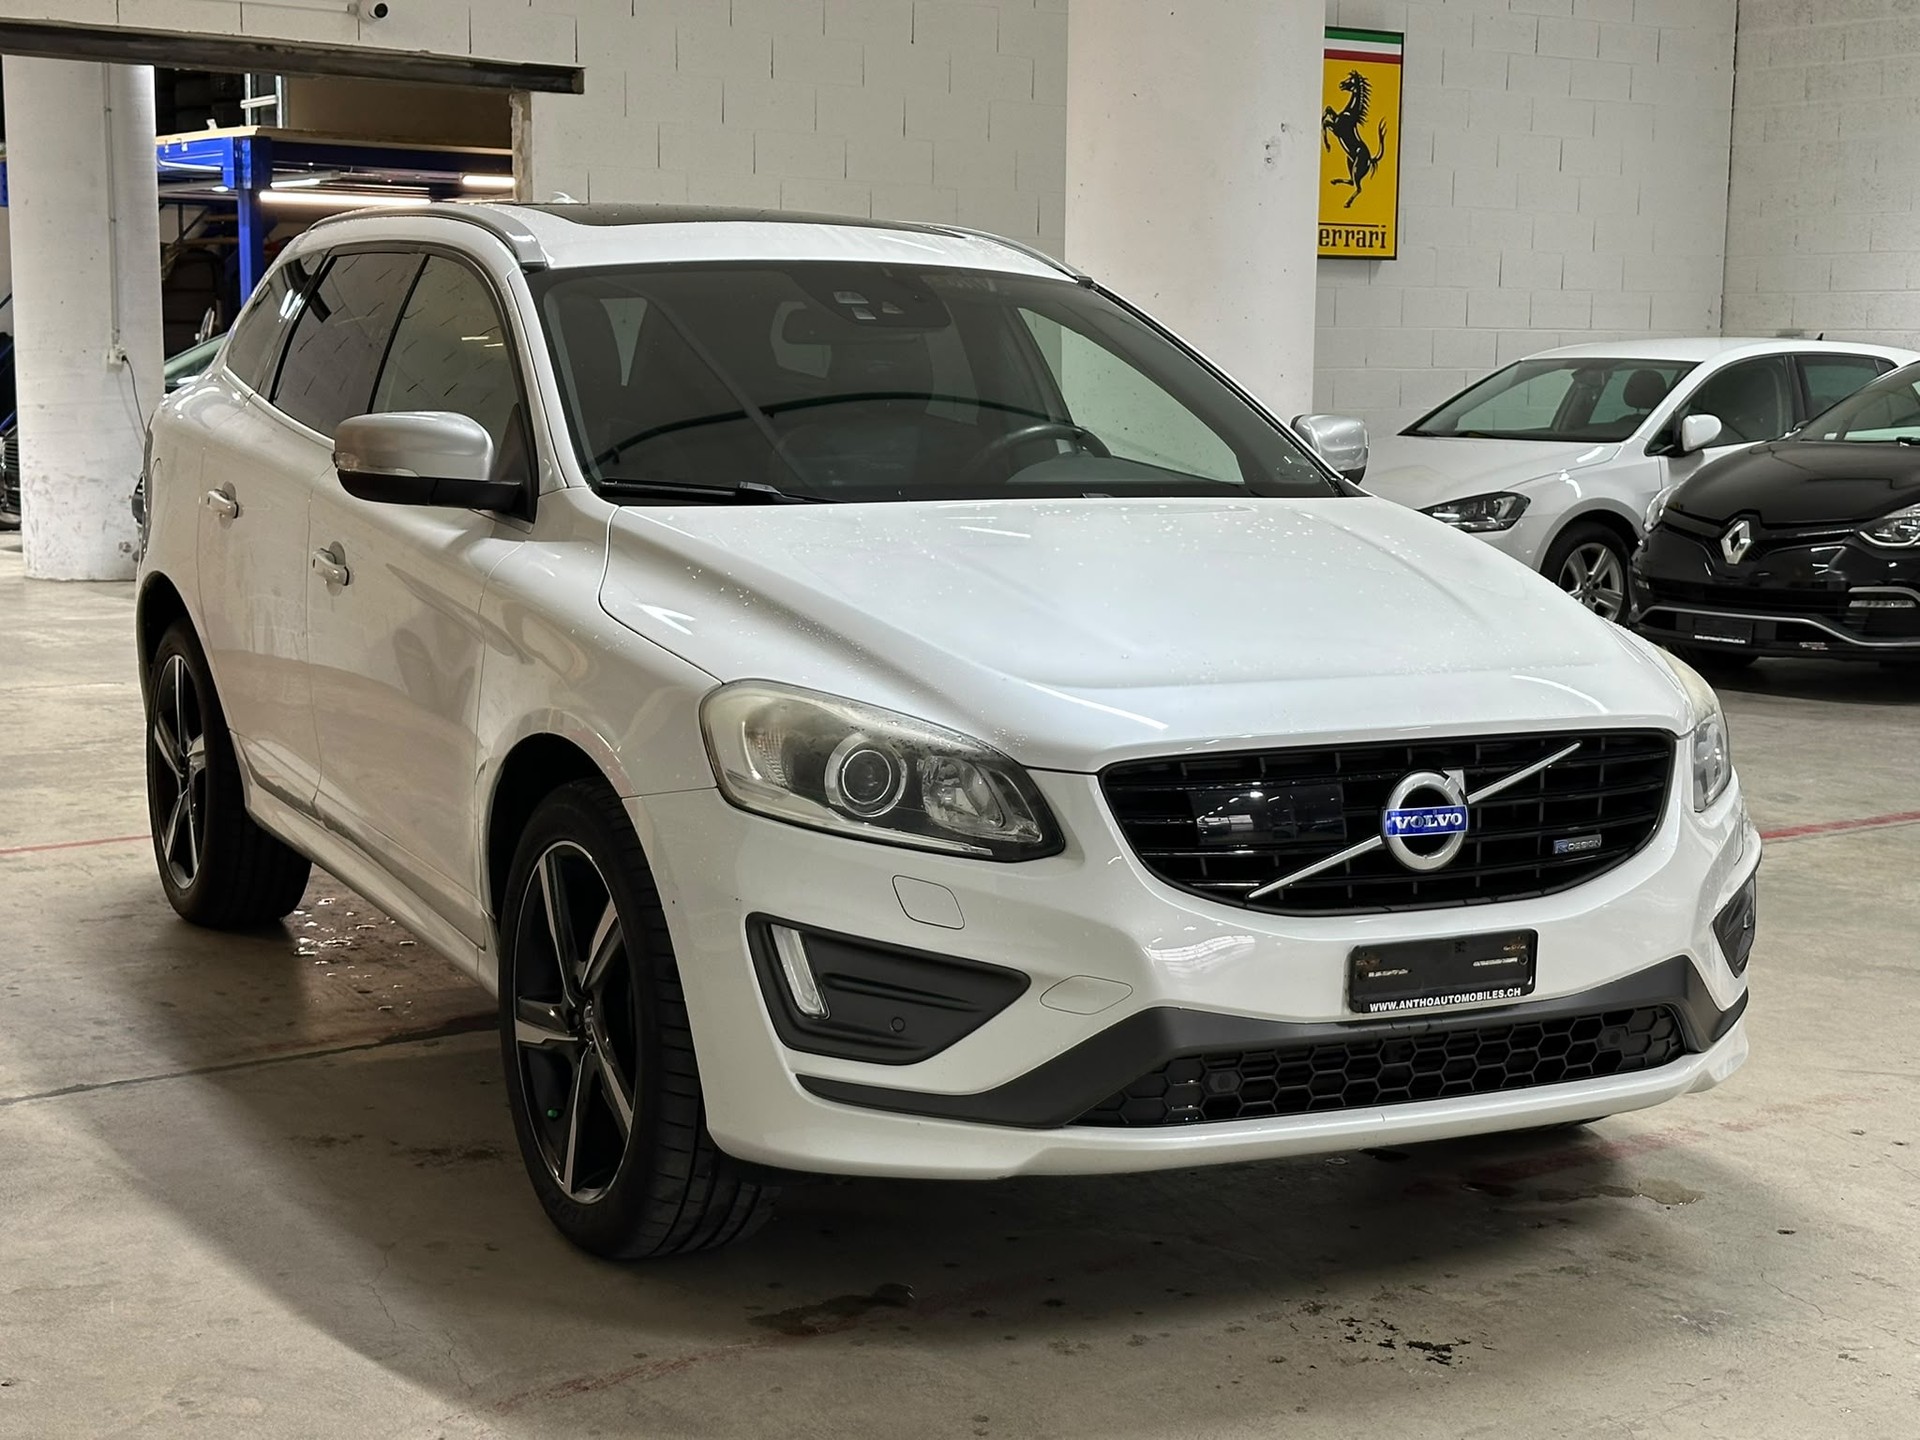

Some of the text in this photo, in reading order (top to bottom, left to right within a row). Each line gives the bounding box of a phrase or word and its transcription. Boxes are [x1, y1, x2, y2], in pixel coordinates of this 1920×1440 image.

[1318, 225, 1387, 249] errari
[1392, 813, 1464, 829] VOLVO
[1369, 988, 1522, 1012] WWW.ANTHOAUTOMOBILES.CH
